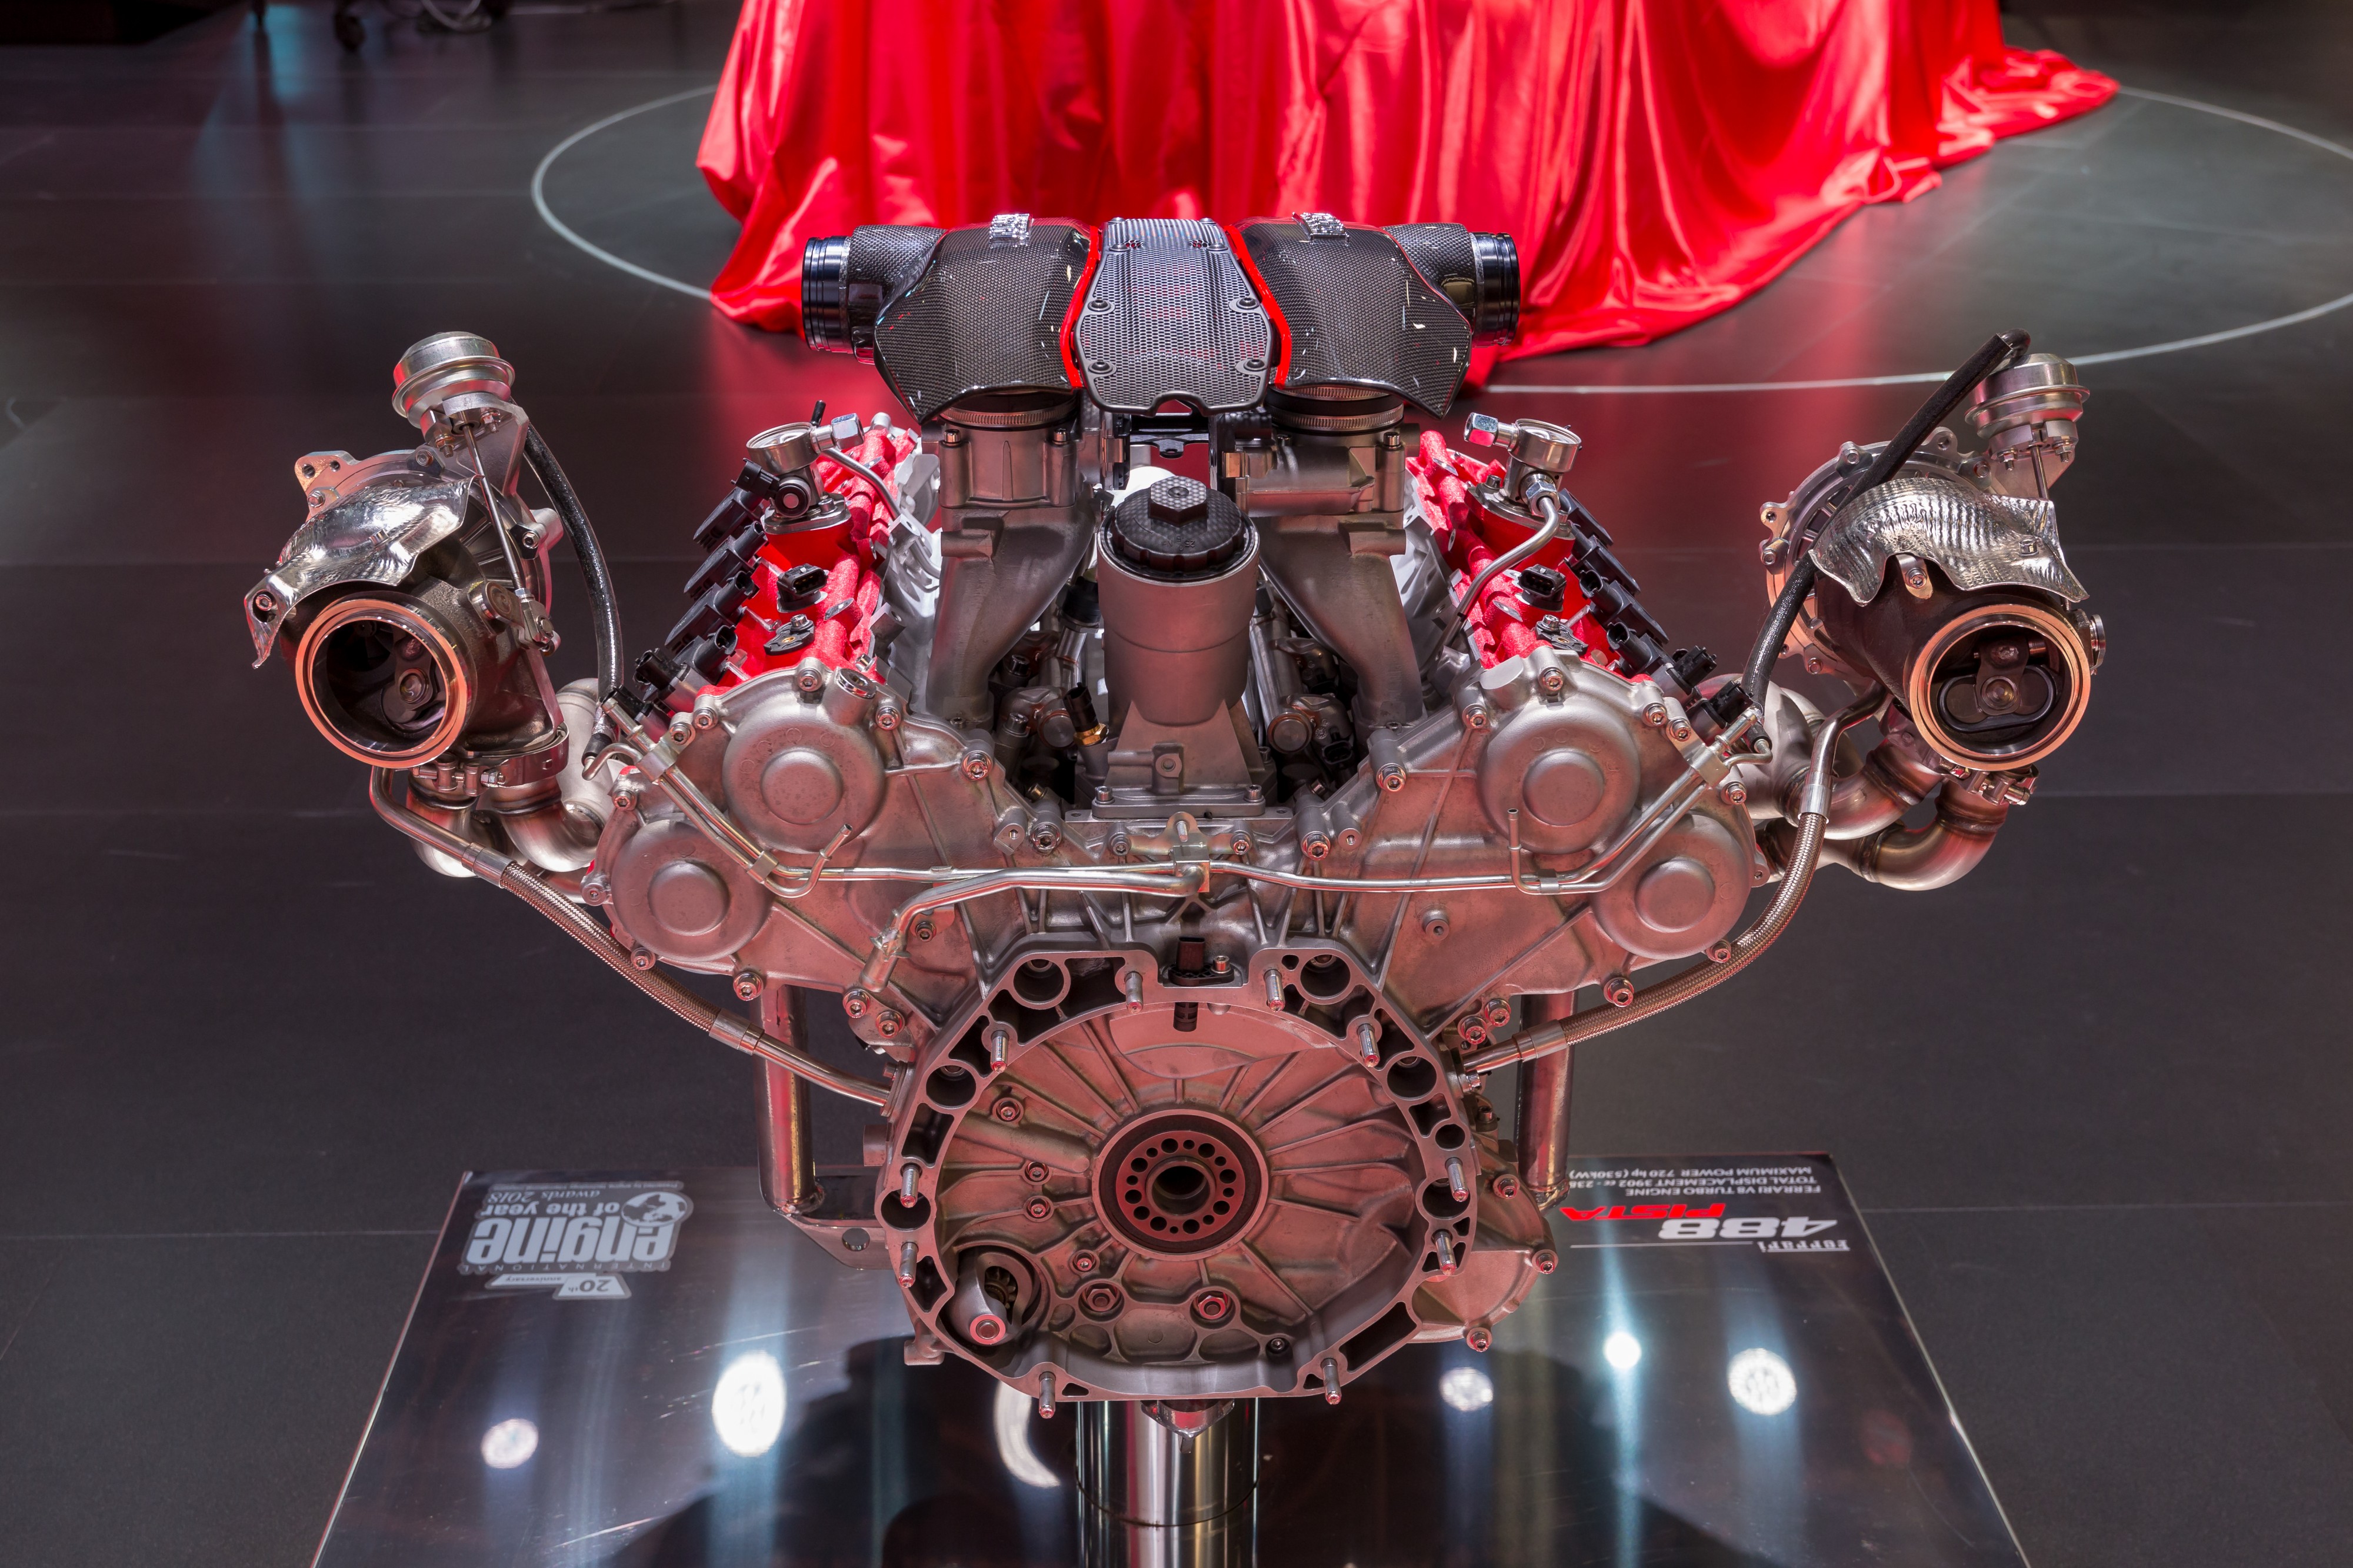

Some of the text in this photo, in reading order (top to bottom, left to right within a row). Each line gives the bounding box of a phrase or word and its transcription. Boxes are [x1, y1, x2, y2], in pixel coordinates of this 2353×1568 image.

[1569, 1166, 1812, 1179] MAXIMUM POWER 720 hp (530kW)
[1619, 1179, 1653, 1187] 3902
[1656, 1177, 1767, 1187] DISPLACEMENT
[1770, 1176, 1818, 1185] TOTAL
[488, 1189, 600, 1204] awards 2018
[1625, 1185, 1821, 1196] FERRARI V8 TURBO ENGINE
[480, 1200, 620, 1217] of the year
[1559, 1203, 1726, 1221] PISTA
[1658, 1216, 1838, 1239] 488
[466, 1215, 674, 1264] engine
[1757, 1239, 1851, 1253] Ferrari
[464, 1262, 665, 1272] INTERNATIONAL
[568, 1279, 612, 1292] 20th
